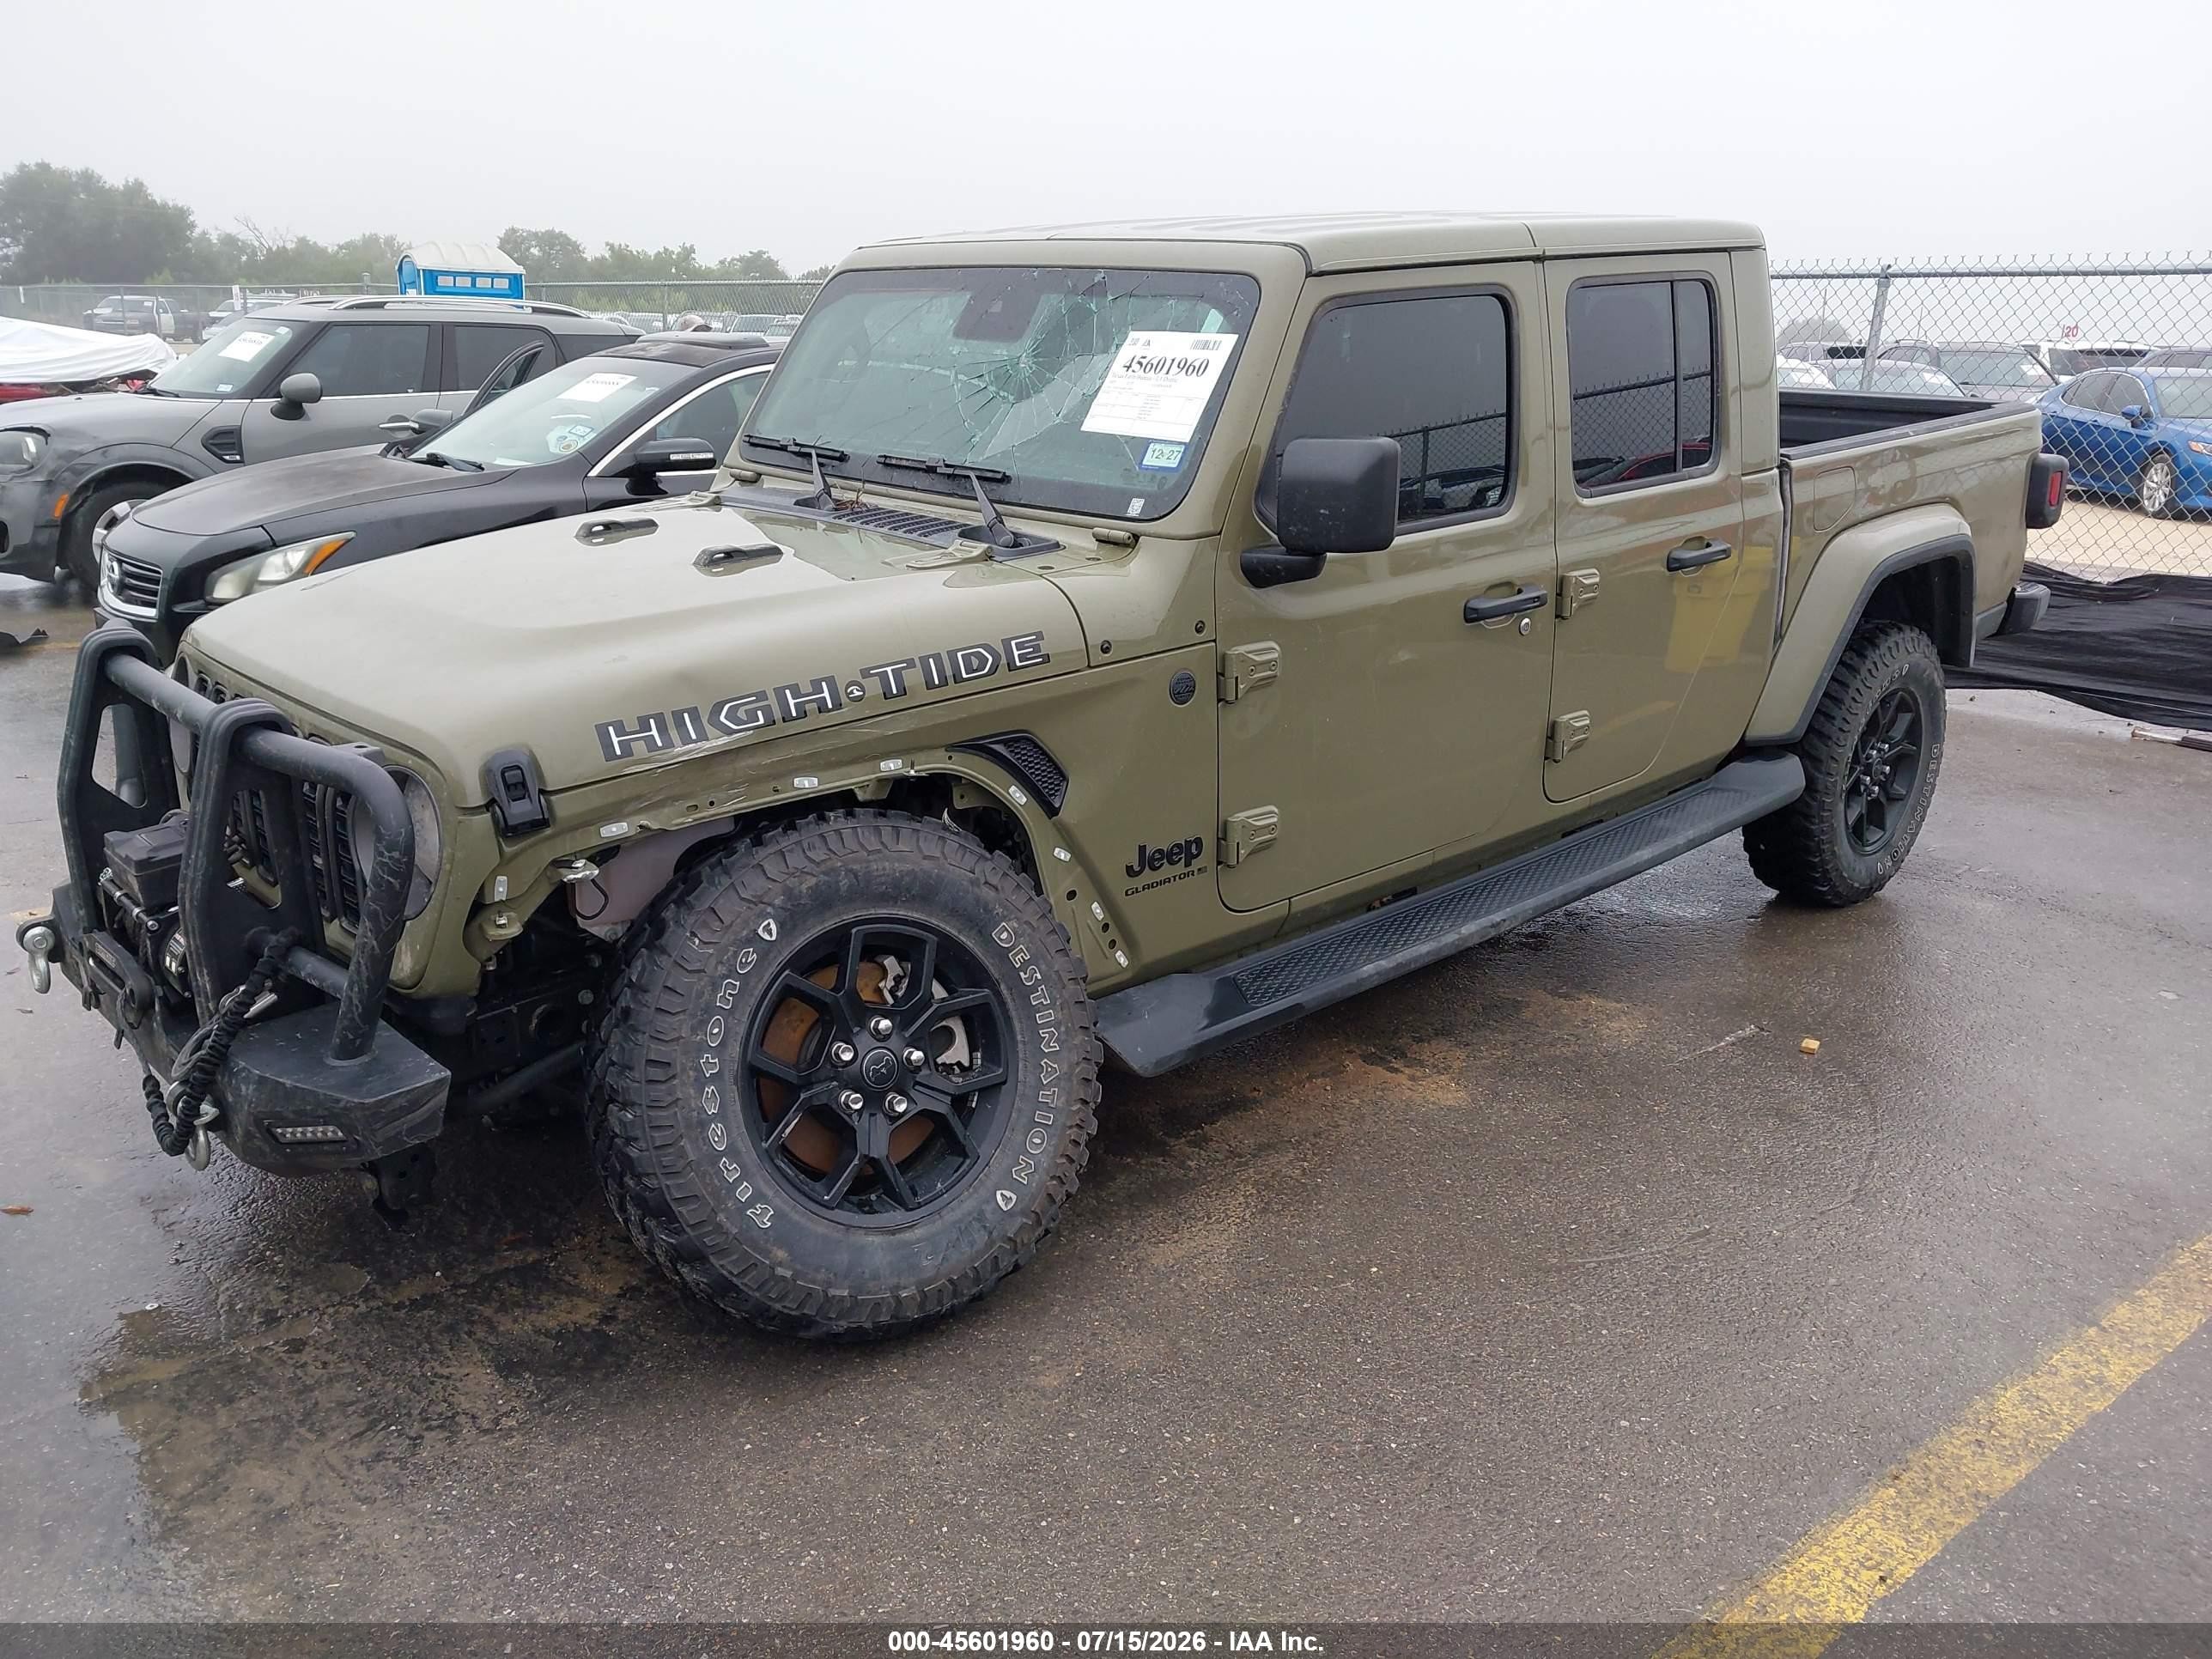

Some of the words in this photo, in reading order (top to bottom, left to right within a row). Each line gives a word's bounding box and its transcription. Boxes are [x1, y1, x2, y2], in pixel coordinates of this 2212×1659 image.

[1122, 355, 1210, 378] 45601960
[594, 674, 842, 762] HIGH
[860, 630, 1051, 700] TIDE
[1125, 836, 1204, 878] Jeep
[1124, 869, 1196, 896] GLADIATOR
[991, 921, 1060, 1185] DESTINATION
